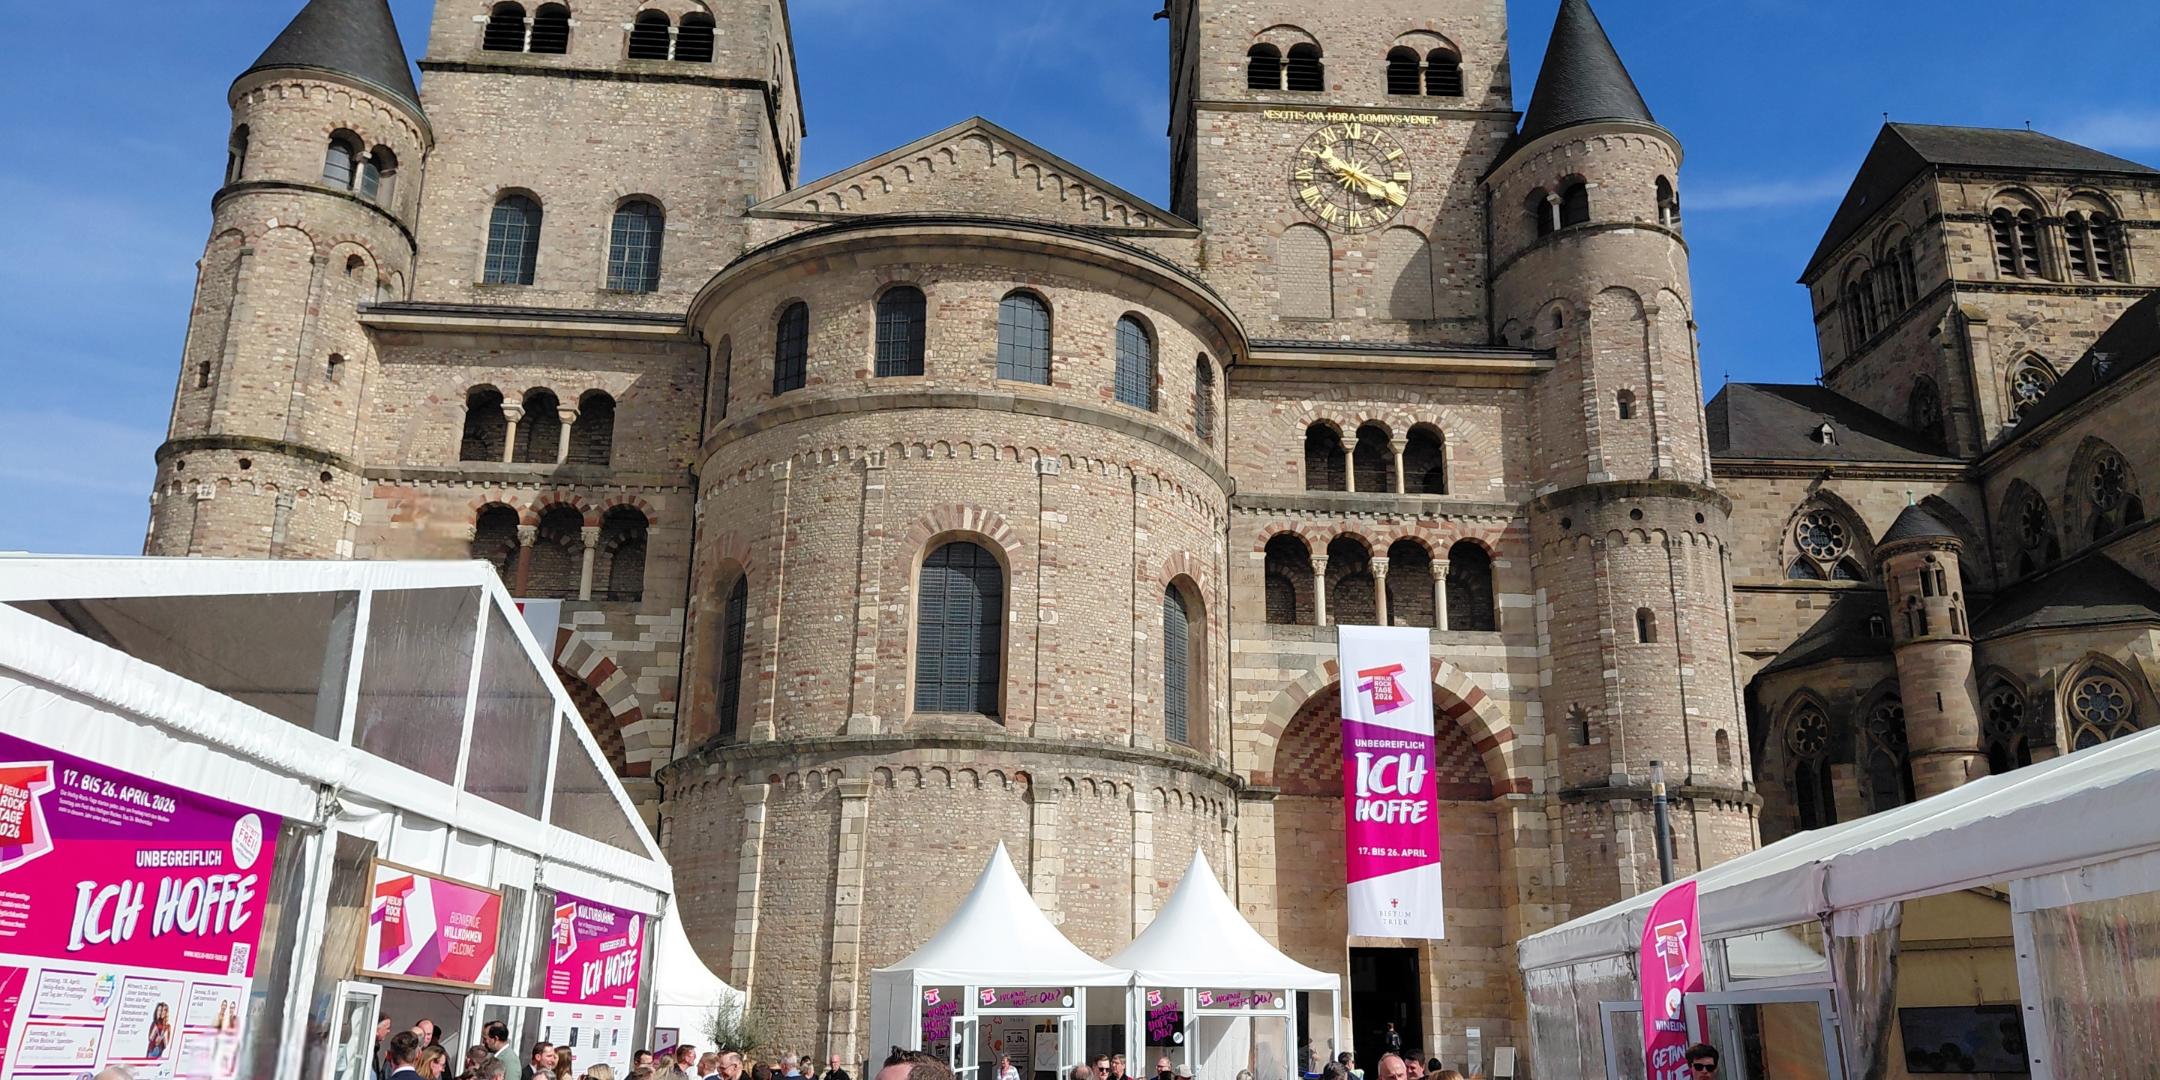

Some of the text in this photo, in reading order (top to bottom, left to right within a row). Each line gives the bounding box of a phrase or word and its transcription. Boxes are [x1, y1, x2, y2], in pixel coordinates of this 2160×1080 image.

[1306, 111, 1325, 121] QVA
[1327, 111, 1356, 122] HORA
[1359, 113, 1402, 123] DOMINVS
[1343, 122, 1360, 139] XII
[1355, 739, 1425, 750] UNBEGREIFLICH
[1354, 752, 1429, 798] ICH
[2, 784, 29, 799] HEILIG
[63, 769, 79, 788] 17.
[80, 774, 102, 793] BIS
[101, 781, 118, 799] 26.
[119, 786, 151, 807] APRIL
[151, 794, 176, 814] 2026
[0, 794, 28, 812] ROCK
[1355, 798, 1429, 824] HOFFE
[0, 822, 20, 839] 026
[136, 850, 222, 867] UNBEGREIFLICH
[1358, 846, 1428, 858] 17. BIS 26. APRIL
[66, 879, 145, 951] ICH
[152, 873, 258, 937] HOFFE
[444, 925, 483, 943] WILLKOMMEN
[447, 941, 476, 957] WELCOME
[580, 959, 603, 1000] ICH
[604, 948, 637, 989] HOFFE
[1253, 991, 1273, 1006] DU?
